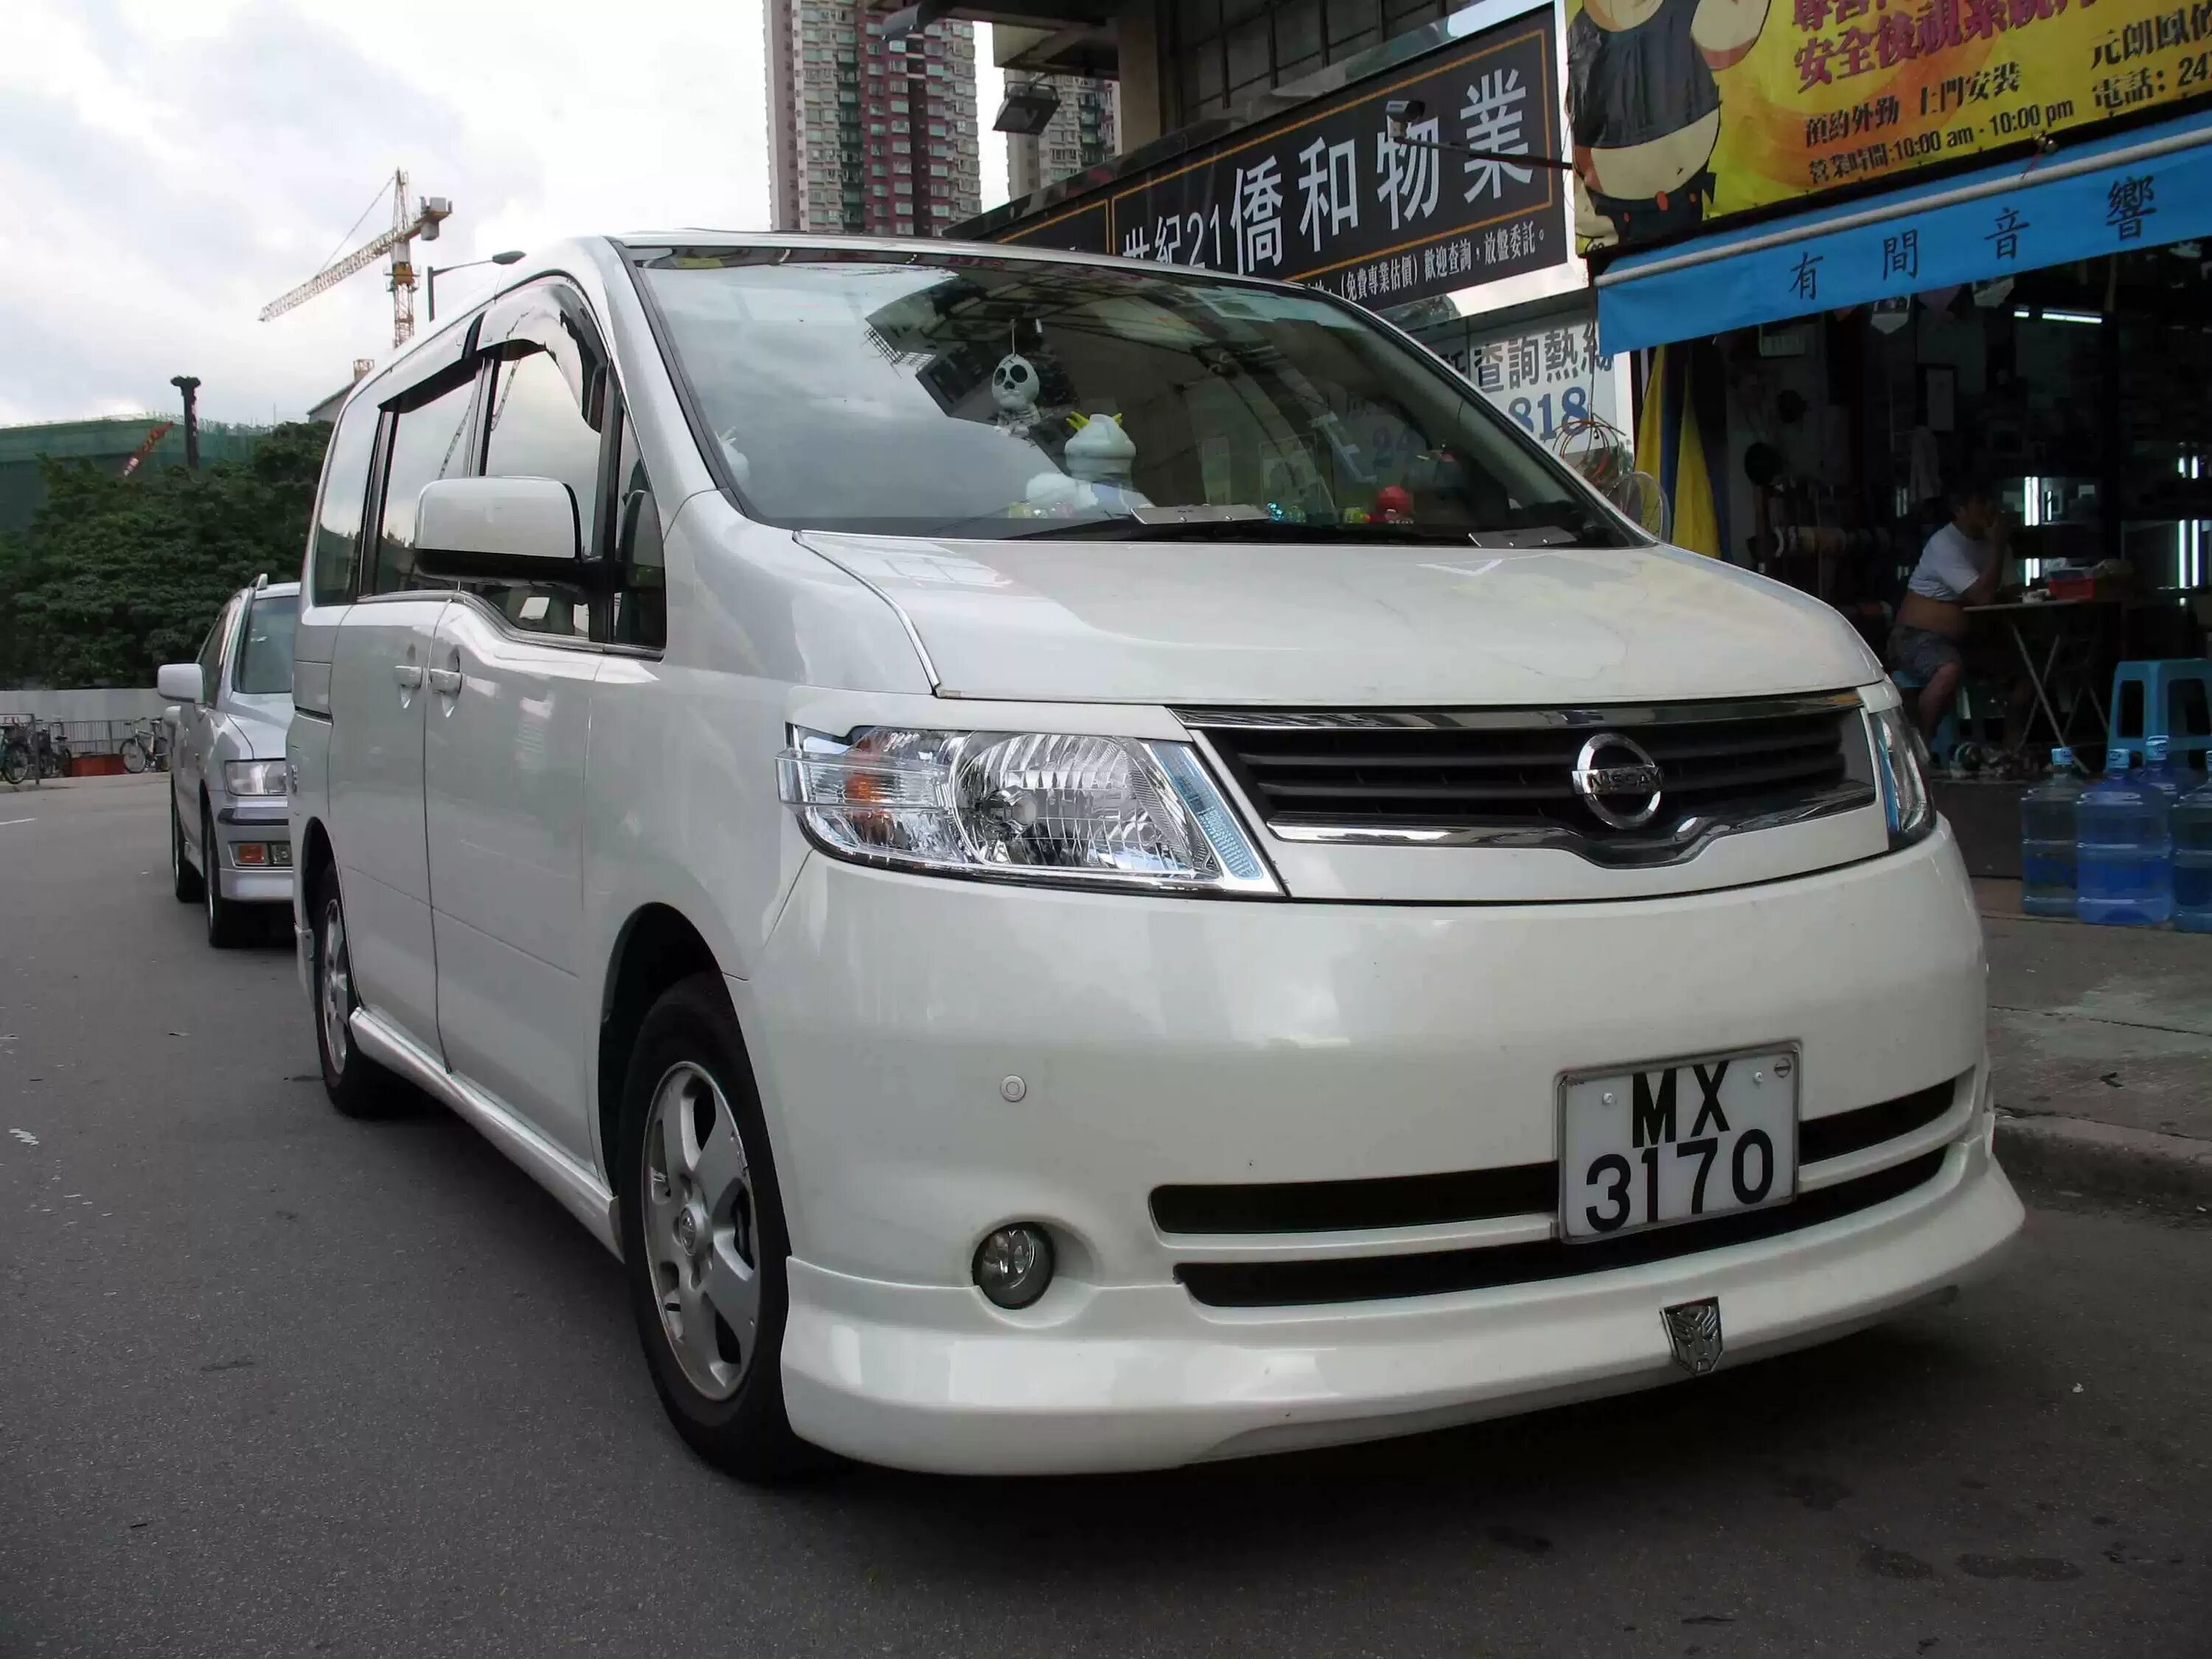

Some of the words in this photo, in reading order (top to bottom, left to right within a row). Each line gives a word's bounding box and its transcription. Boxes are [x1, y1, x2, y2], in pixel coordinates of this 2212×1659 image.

[2178, 52, 2212, 87] 24
[1947, 126, 1975, 147] am
[1989, 103, 2041, 136] 10:00
[2046, 100, 2074, 127] pm
[1632, 1060, 1731, 1148] MX
[1586, 1128, 1774, 1233] 3170
